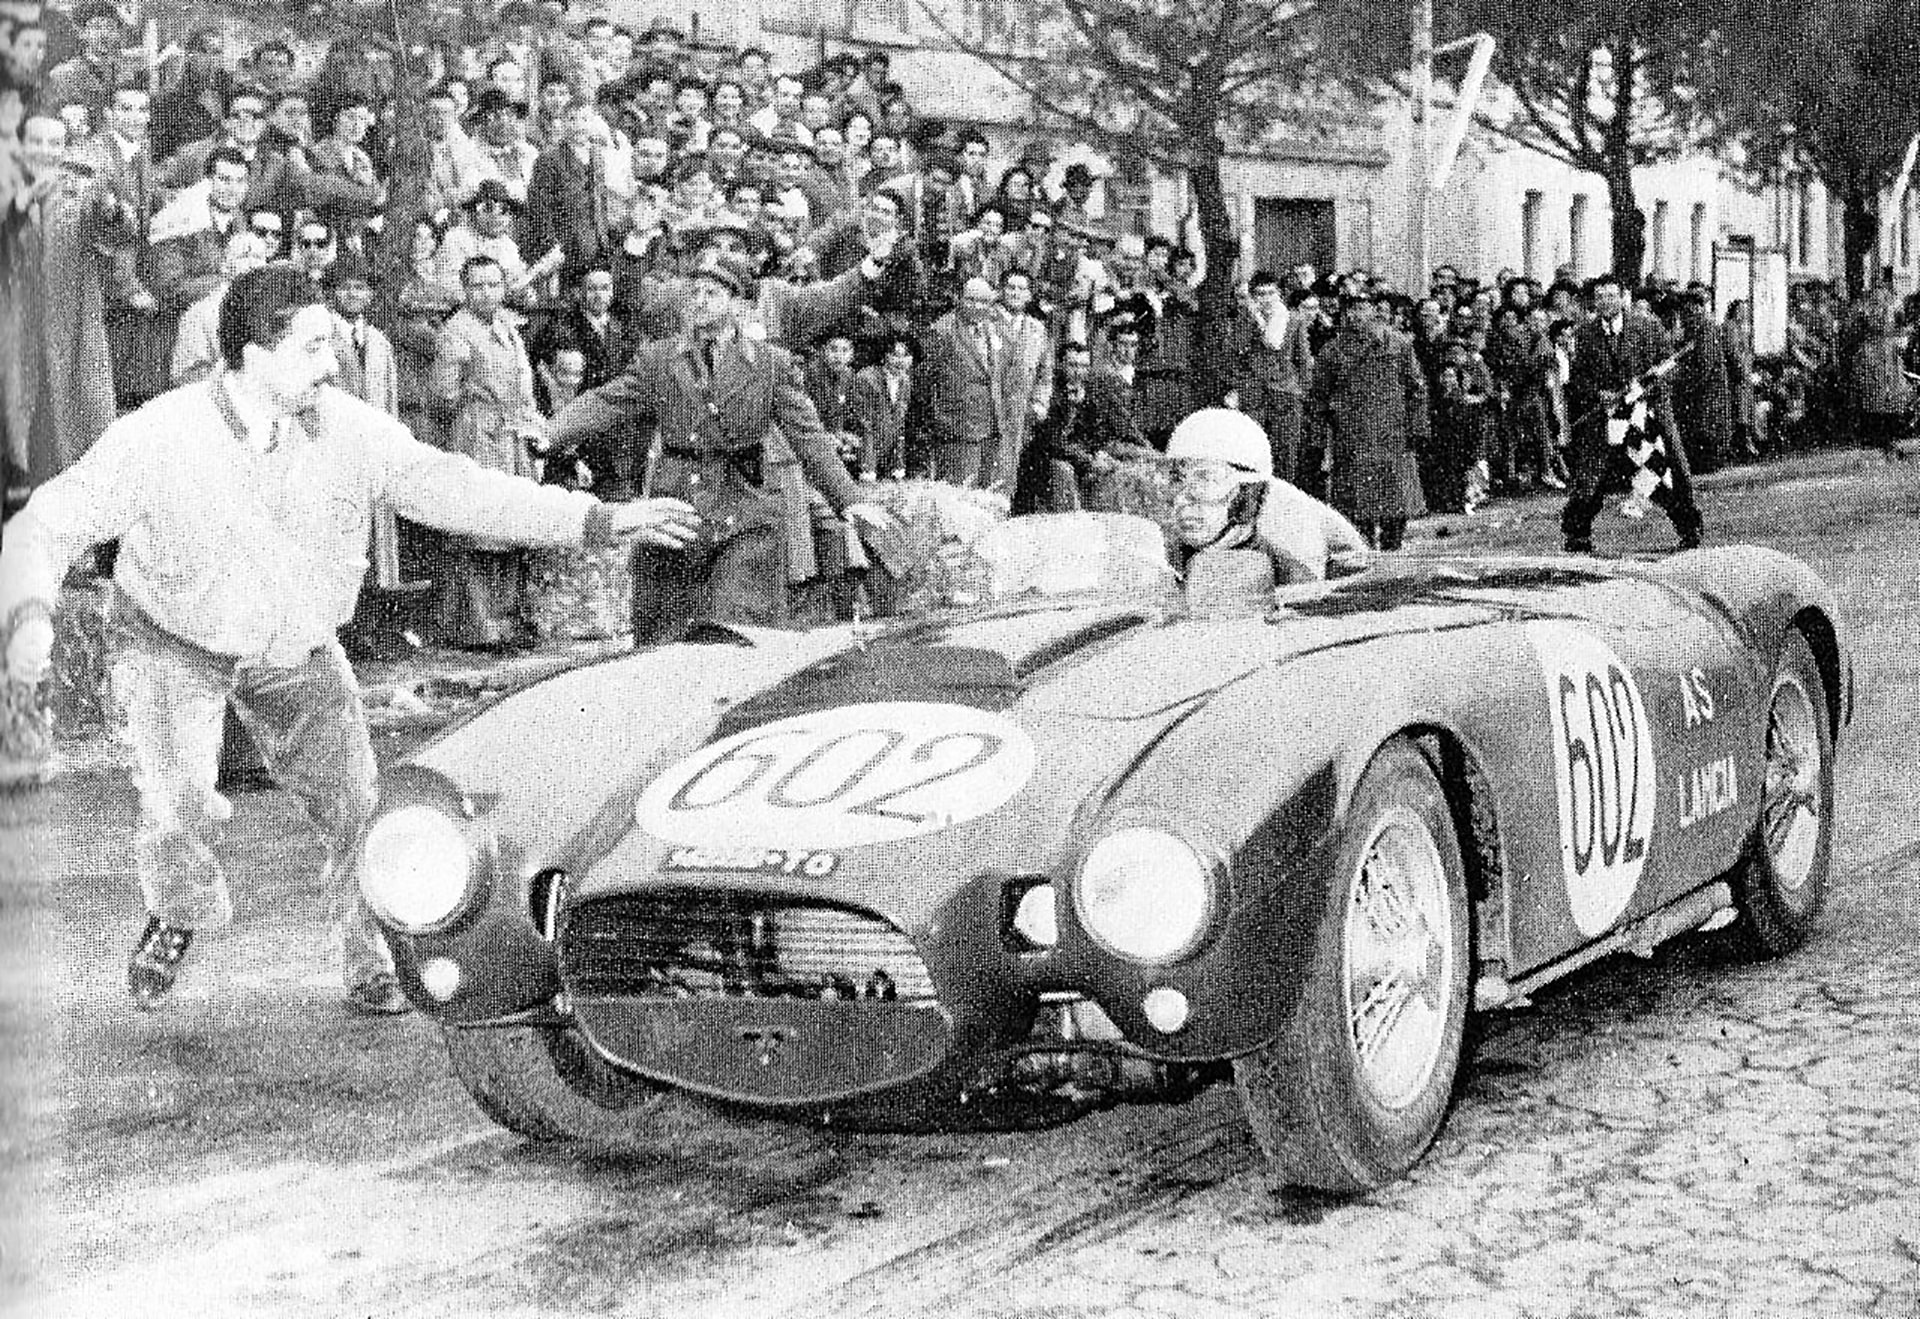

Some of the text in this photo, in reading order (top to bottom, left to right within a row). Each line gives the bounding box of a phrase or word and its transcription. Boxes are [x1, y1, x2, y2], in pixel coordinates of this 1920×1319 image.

[1679, 667, 1713, 728] AS
[667, 728, 1002, 823] 602
[1559, 664, 1645, 876] 602
